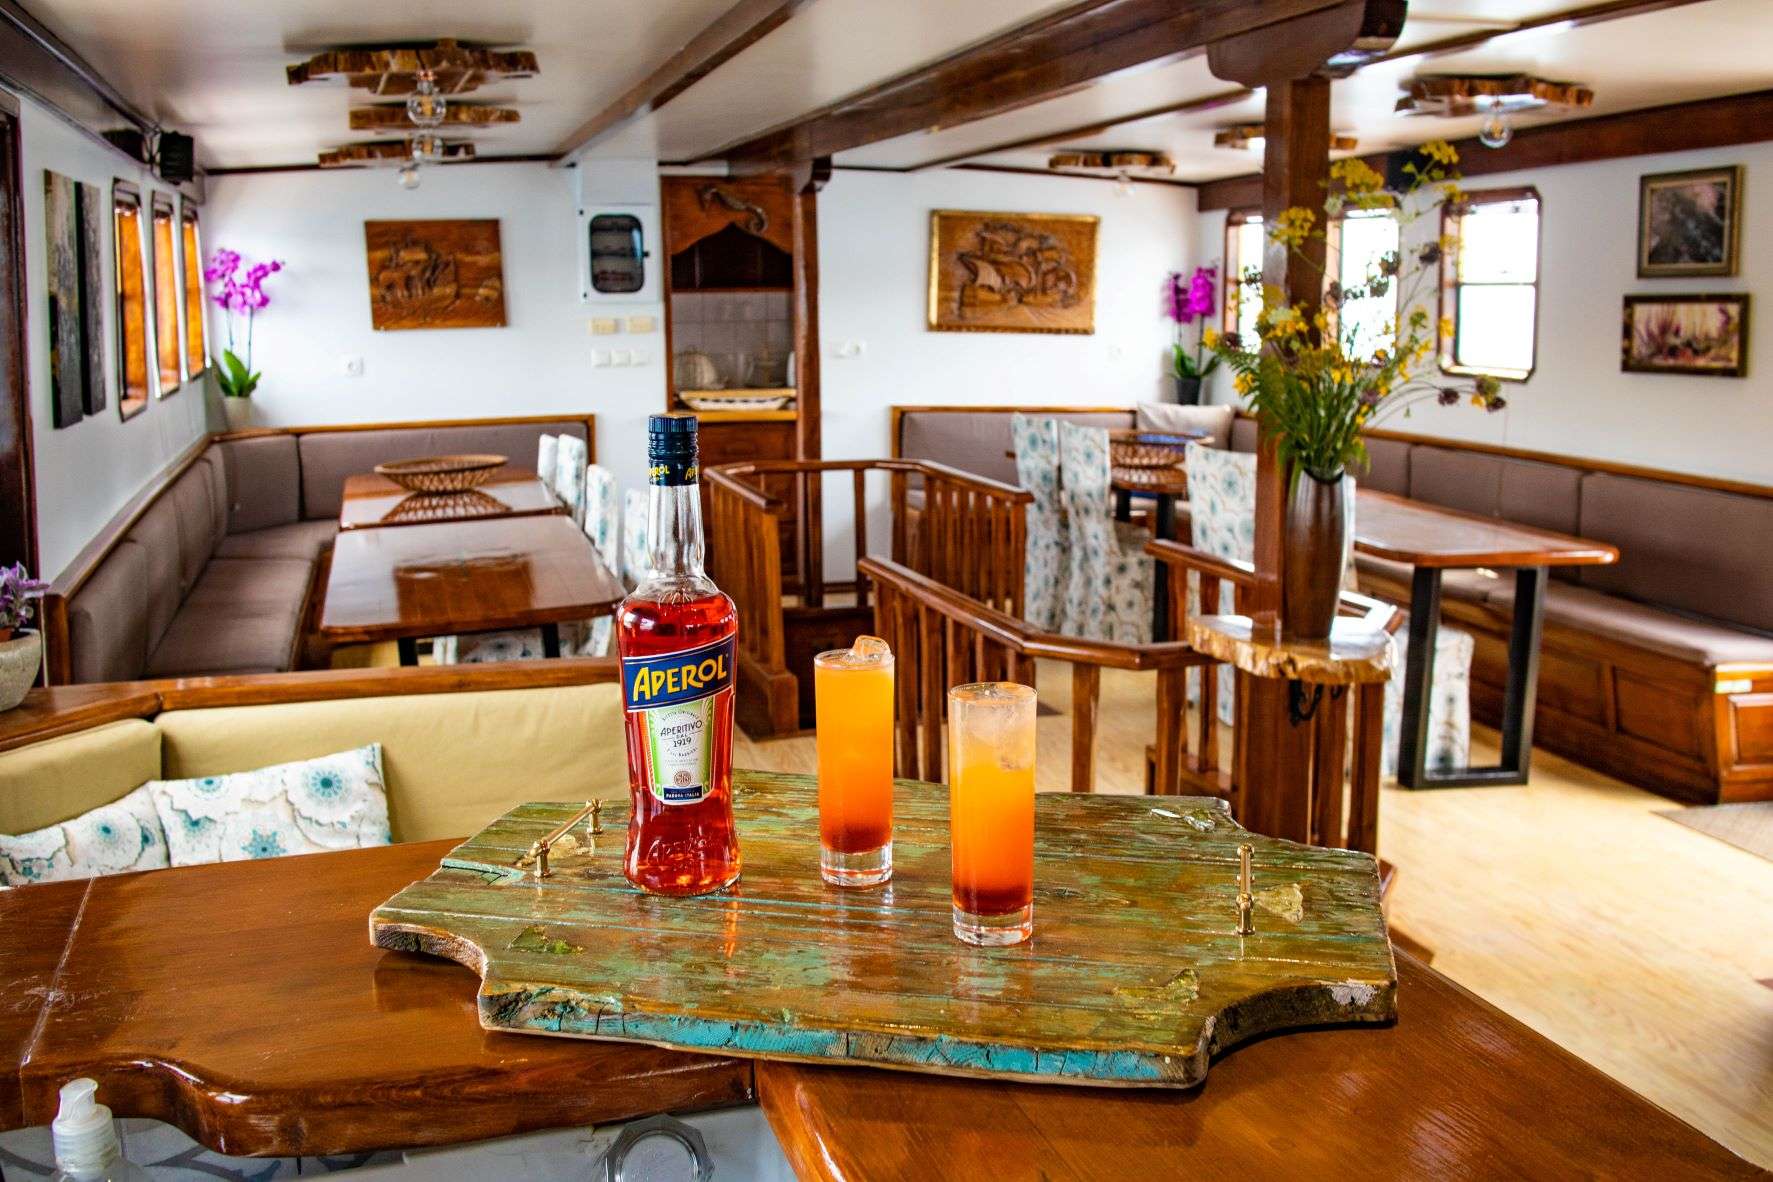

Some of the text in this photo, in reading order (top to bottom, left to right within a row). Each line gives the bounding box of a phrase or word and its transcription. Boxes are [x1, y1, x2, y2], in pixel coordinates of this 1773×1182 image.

[633, 654, 727, 702] APEROL
[660, 719, 703, 737] APERITIVO
[673, 736, 692, 748] 1919
